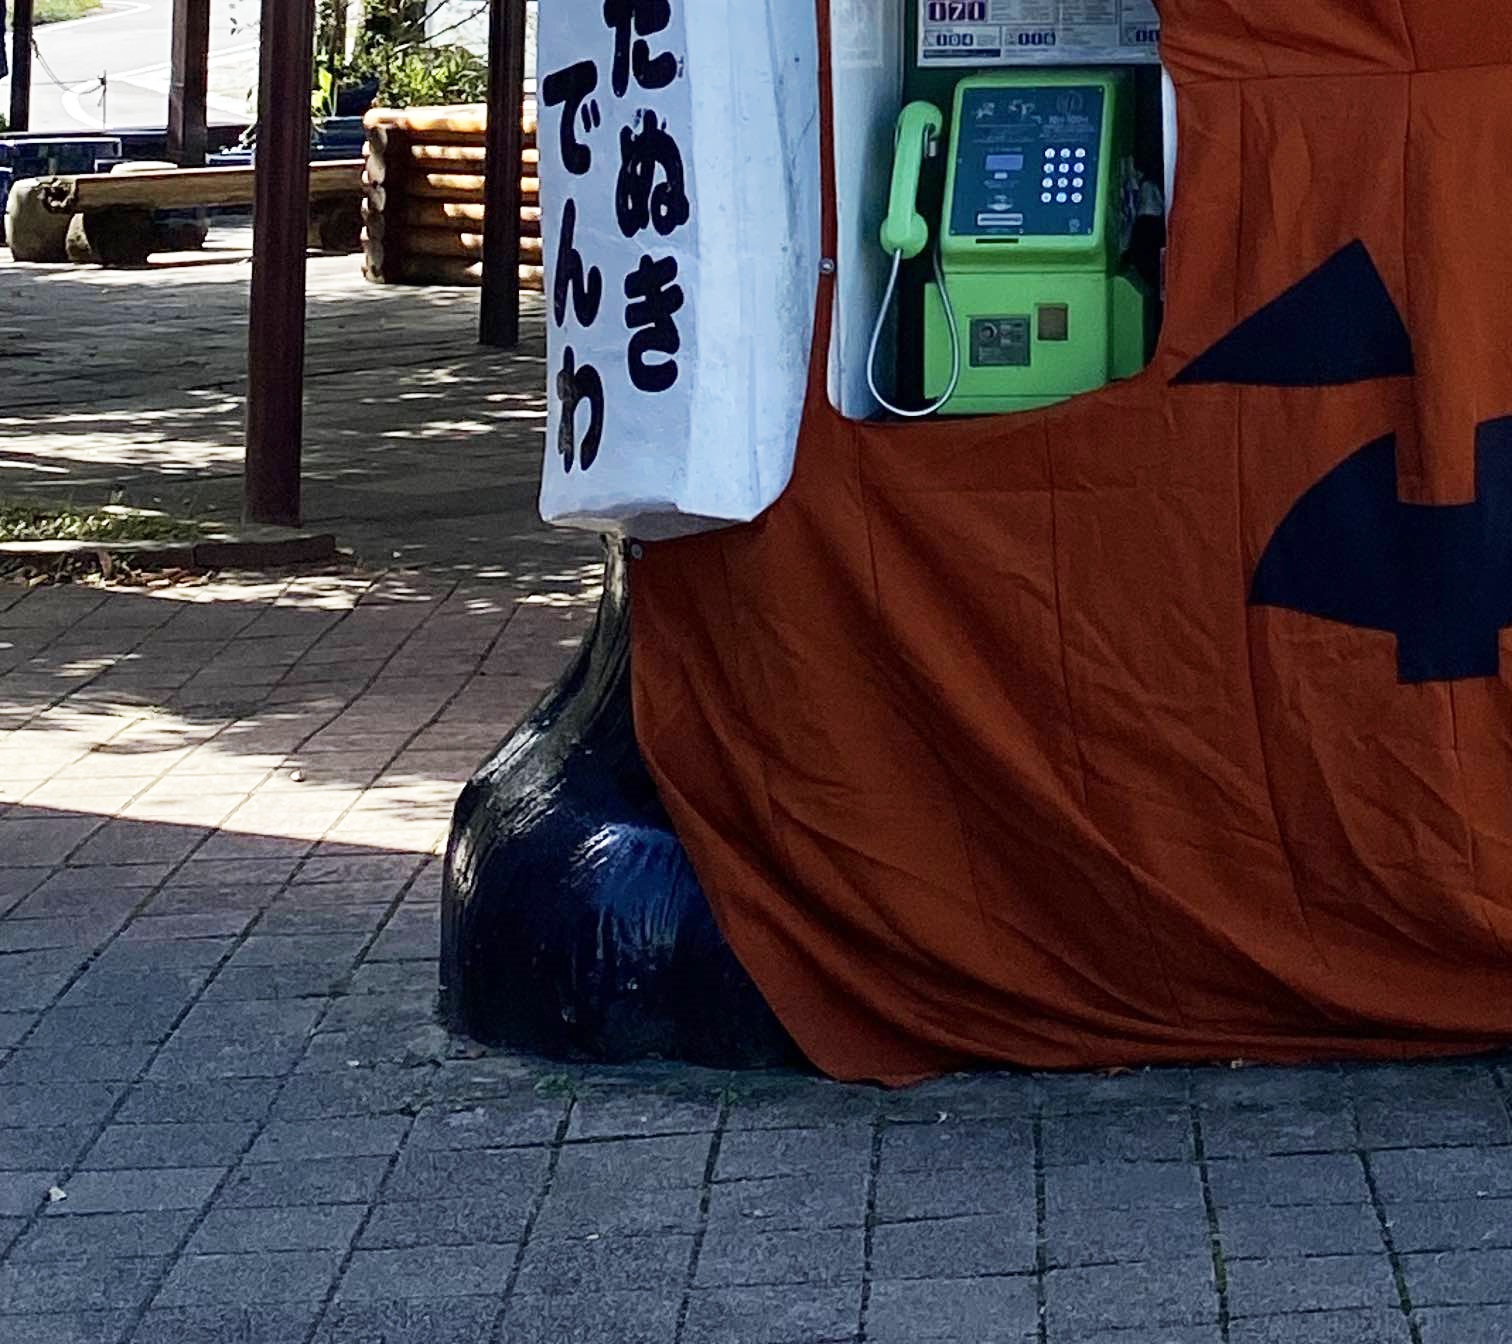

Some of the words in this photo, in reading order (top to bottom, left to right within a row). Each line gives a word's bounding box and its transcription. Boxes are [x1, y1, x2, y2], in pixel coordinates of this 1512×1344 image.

[932, 3, 981, 20] 171
[543, 59, 603, 473] でんわ
